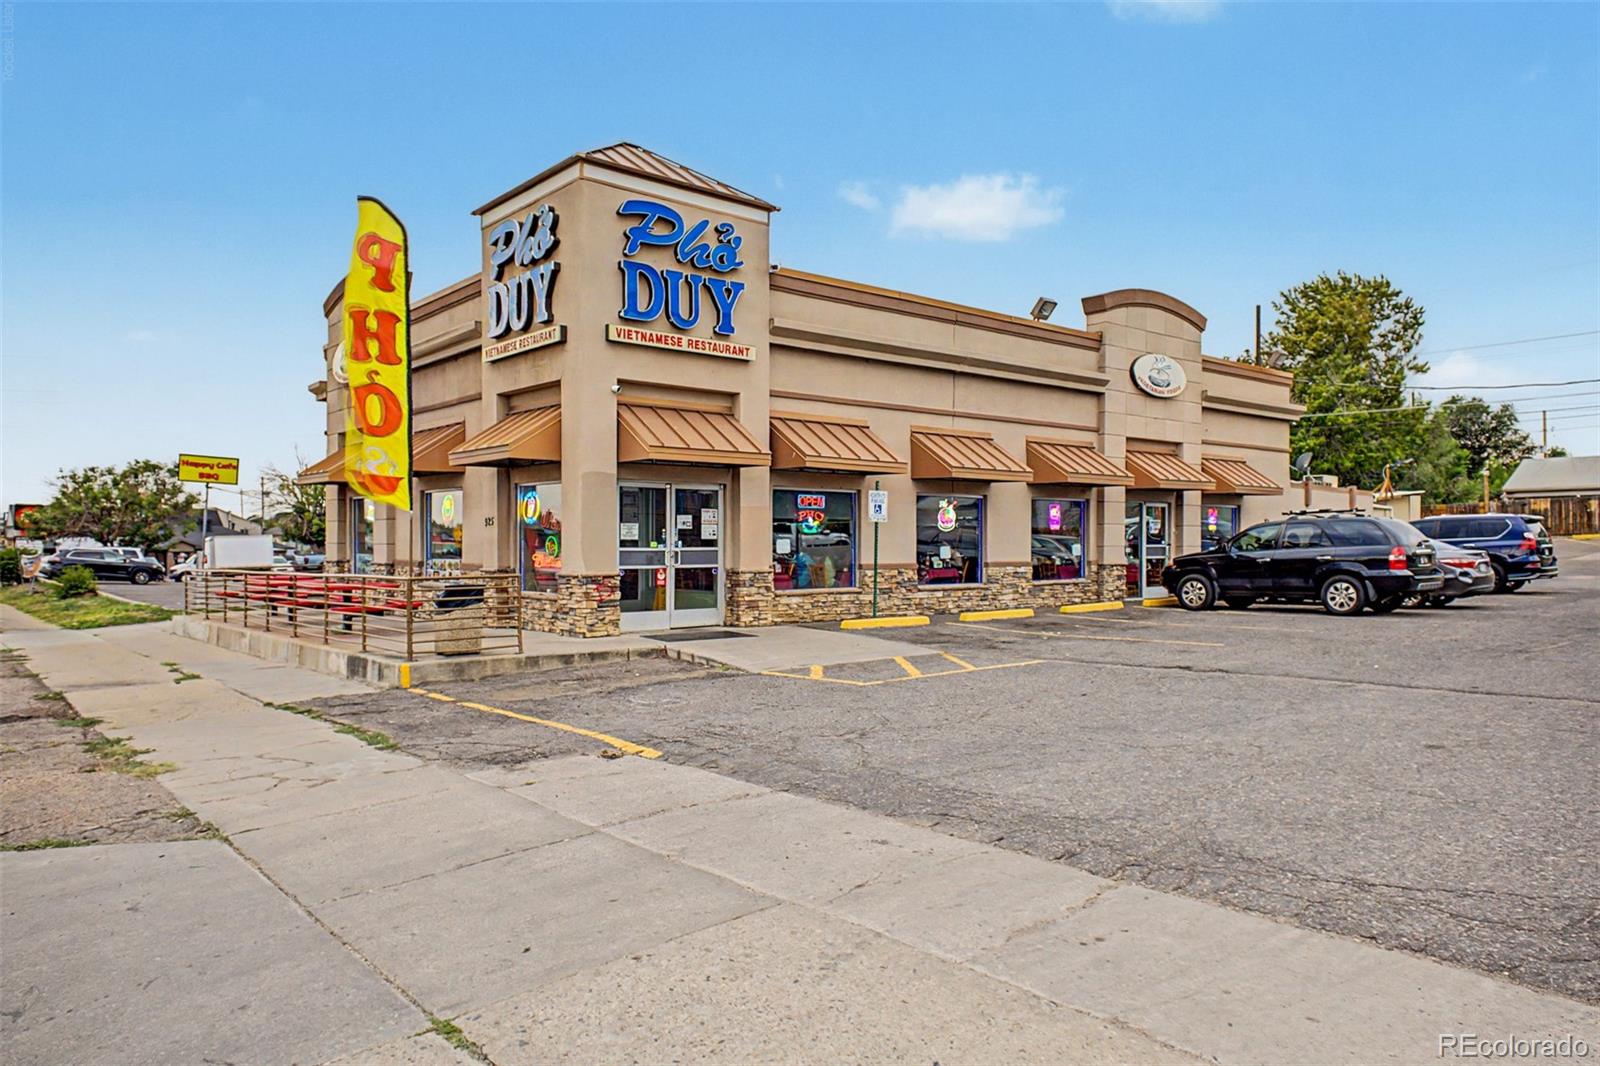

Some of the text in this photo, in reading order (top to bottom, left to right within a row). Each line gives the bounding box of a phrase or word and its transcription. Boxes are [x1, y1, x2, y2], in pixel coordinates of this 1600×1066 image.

[487, 261, 557, 339] DUY
[619, 259, 746, 335] DUY
[485, 328, 557, 359] VIETNAMESE RESTAURANT
[615, 327, 751, 357] VIETNAMESE RESTAURANT
[181, 459, 215, 470] Happy
[198, 472, 220, 481] BBQ
[799, 496, 824, 506] OPEN
[797, 510, 825, 522] PHO
